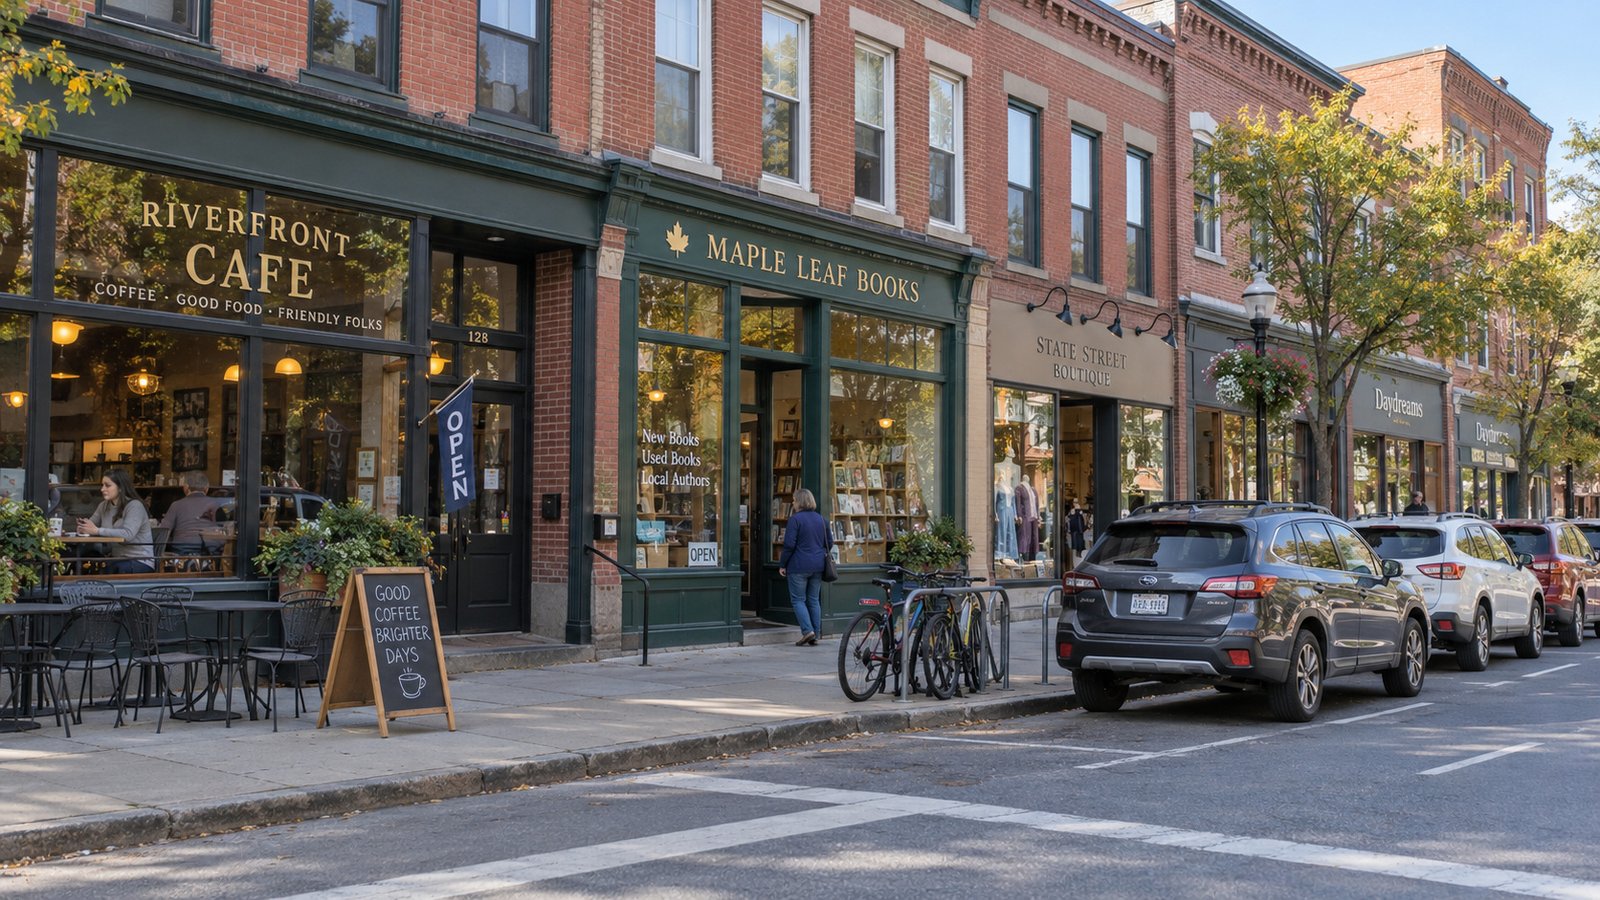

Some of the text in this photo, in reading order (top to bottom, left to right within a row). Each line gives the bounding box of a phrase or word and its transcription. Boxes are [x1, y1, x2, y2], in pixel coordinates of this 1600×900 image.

[141, 201, 350, 257] RIVERFRONT
[186, 243, 313, 299] CAFE
[707, 233, 919, 303] MAPLE LEAF BOOKS
[94, 282, 383, 330] COFFEE GOOD FOOD FRIENDLY FOLKS
[468, 331, 489, 344] 128
[1036, 335, 1127, 369] STATE STREET
[1053, 363, 1110, 387] BOUTIQUE
[1375, 388, 1423, 418] Daydreams
[642, 428, 700, 447] New Books
[446, 410, 469, 501] OPEN
[642, 449, 702, 467] Used Books
[641, 470, 711, 487] Local Authors
[690, 547, 716, 562] OPEN
[375, 584, 411, 602] GOOD
[375, 605, 421, 622] COFFEE
[375, 625, 432, 643] BRIGHTER
[385, 646, 420, 664] DAYS
